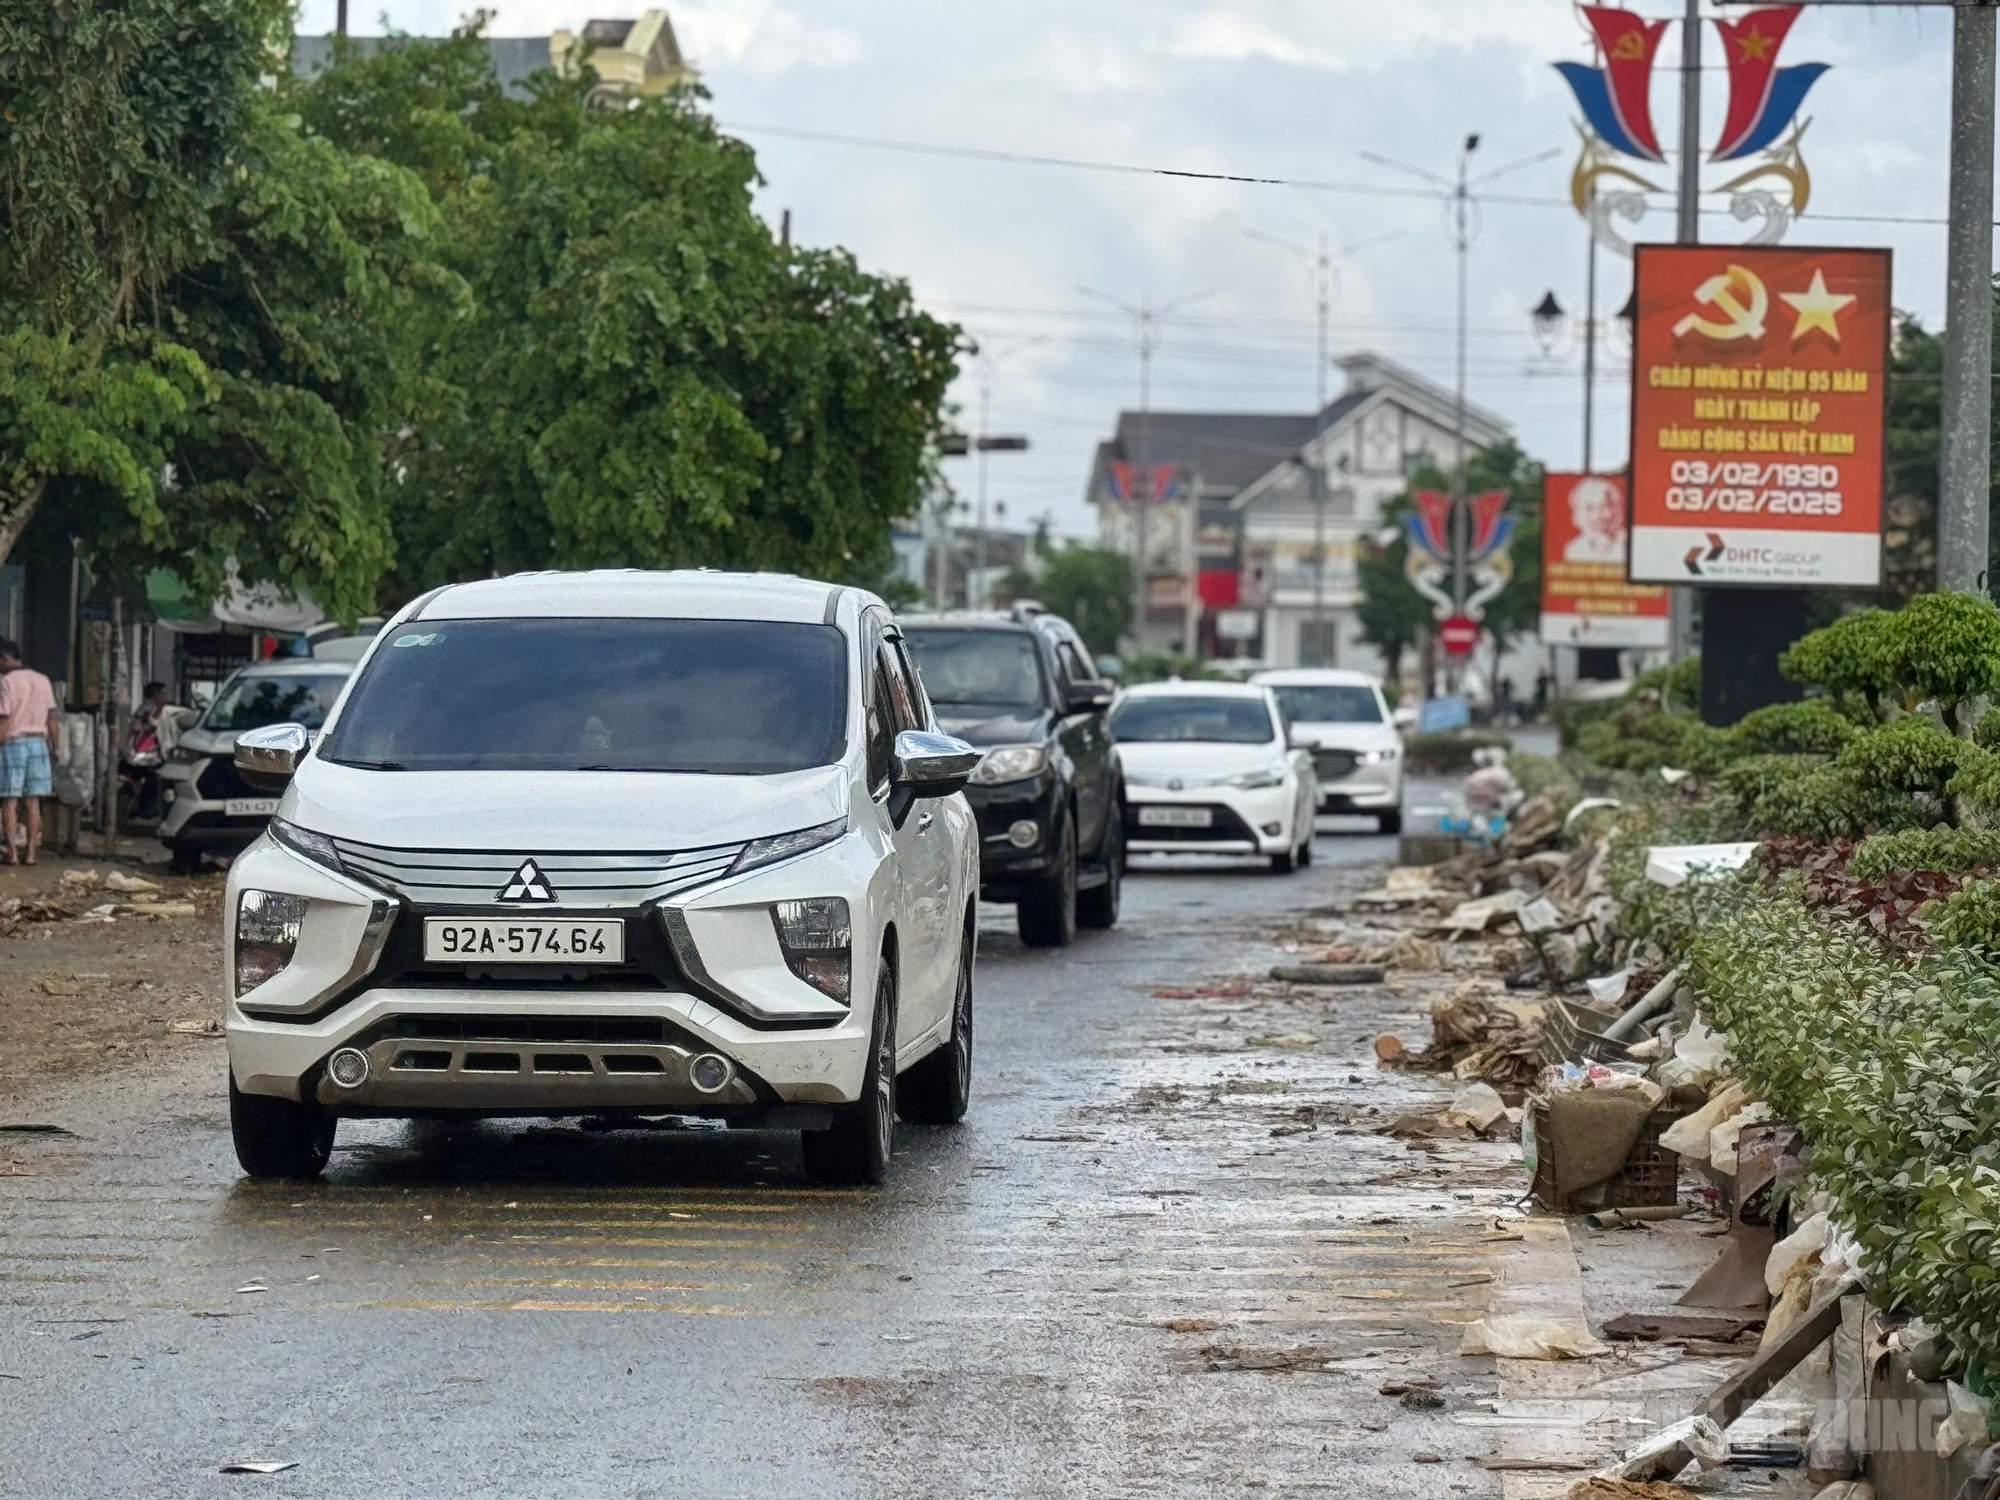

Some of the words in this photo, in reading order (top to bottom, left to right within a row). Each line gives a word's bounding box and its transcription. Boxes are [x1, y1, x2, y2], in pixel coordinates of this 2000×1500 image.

[1808, 370, 1831, 392] 95
[1819, 432, 1855, 454] NAM
[1671, 460, 1839, 488] 03/02/1930
[1665, 487, 1843, 516] 03/02/2025
[1727, 547, 1773, 564] DHTC
[1774, 551, 1822, 566] GROUP
[441, 926, 607, 954] 92A-574.64
